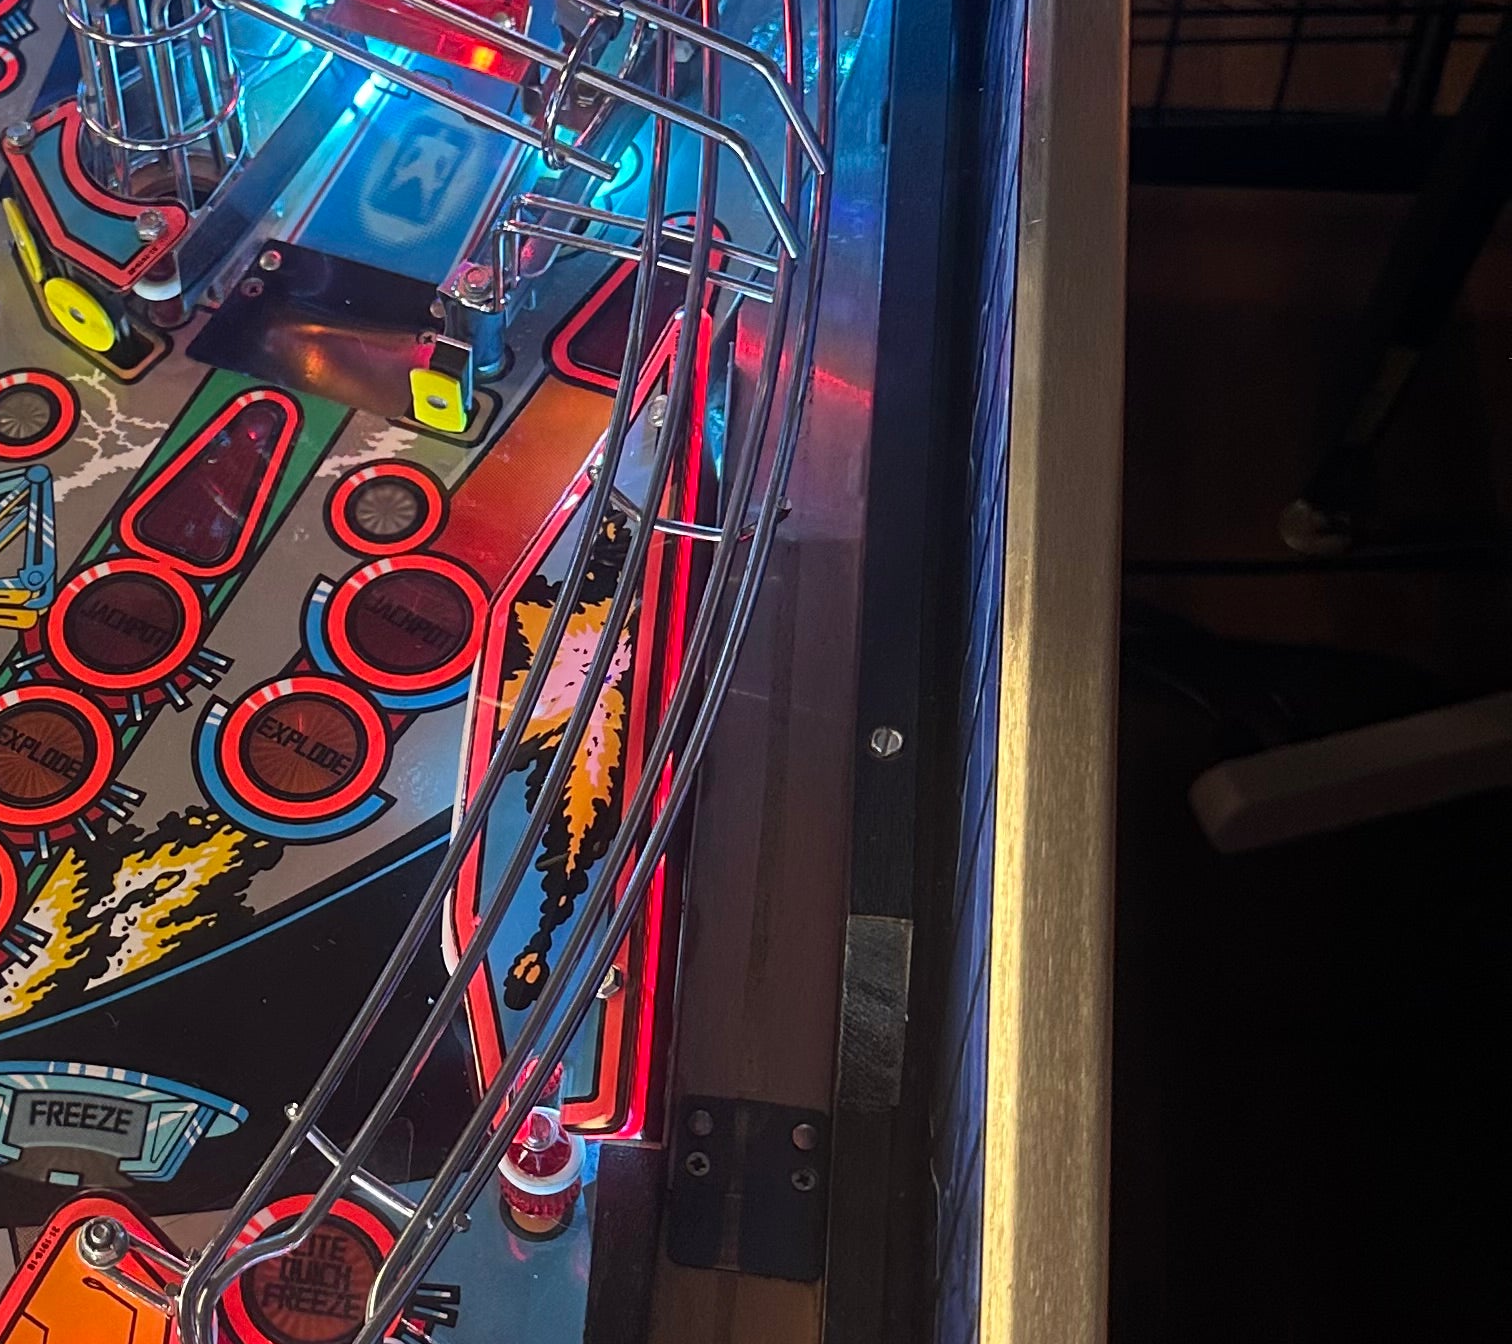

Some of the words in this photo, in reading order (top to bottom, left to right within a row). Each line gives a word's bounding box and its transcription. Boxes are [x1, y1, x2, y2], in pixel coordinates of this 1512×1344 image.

[80, 599, 171, 648] JACKPOT
[364, 593, 459, 654] JACKPOT
[256, 715, 352, 777] EXPLODE
[28, 1098, 133, 1136] FREEZE
[279, 1256, 353, 1293] QUICK
[261, 1283, 362, 1322] FREEZE
